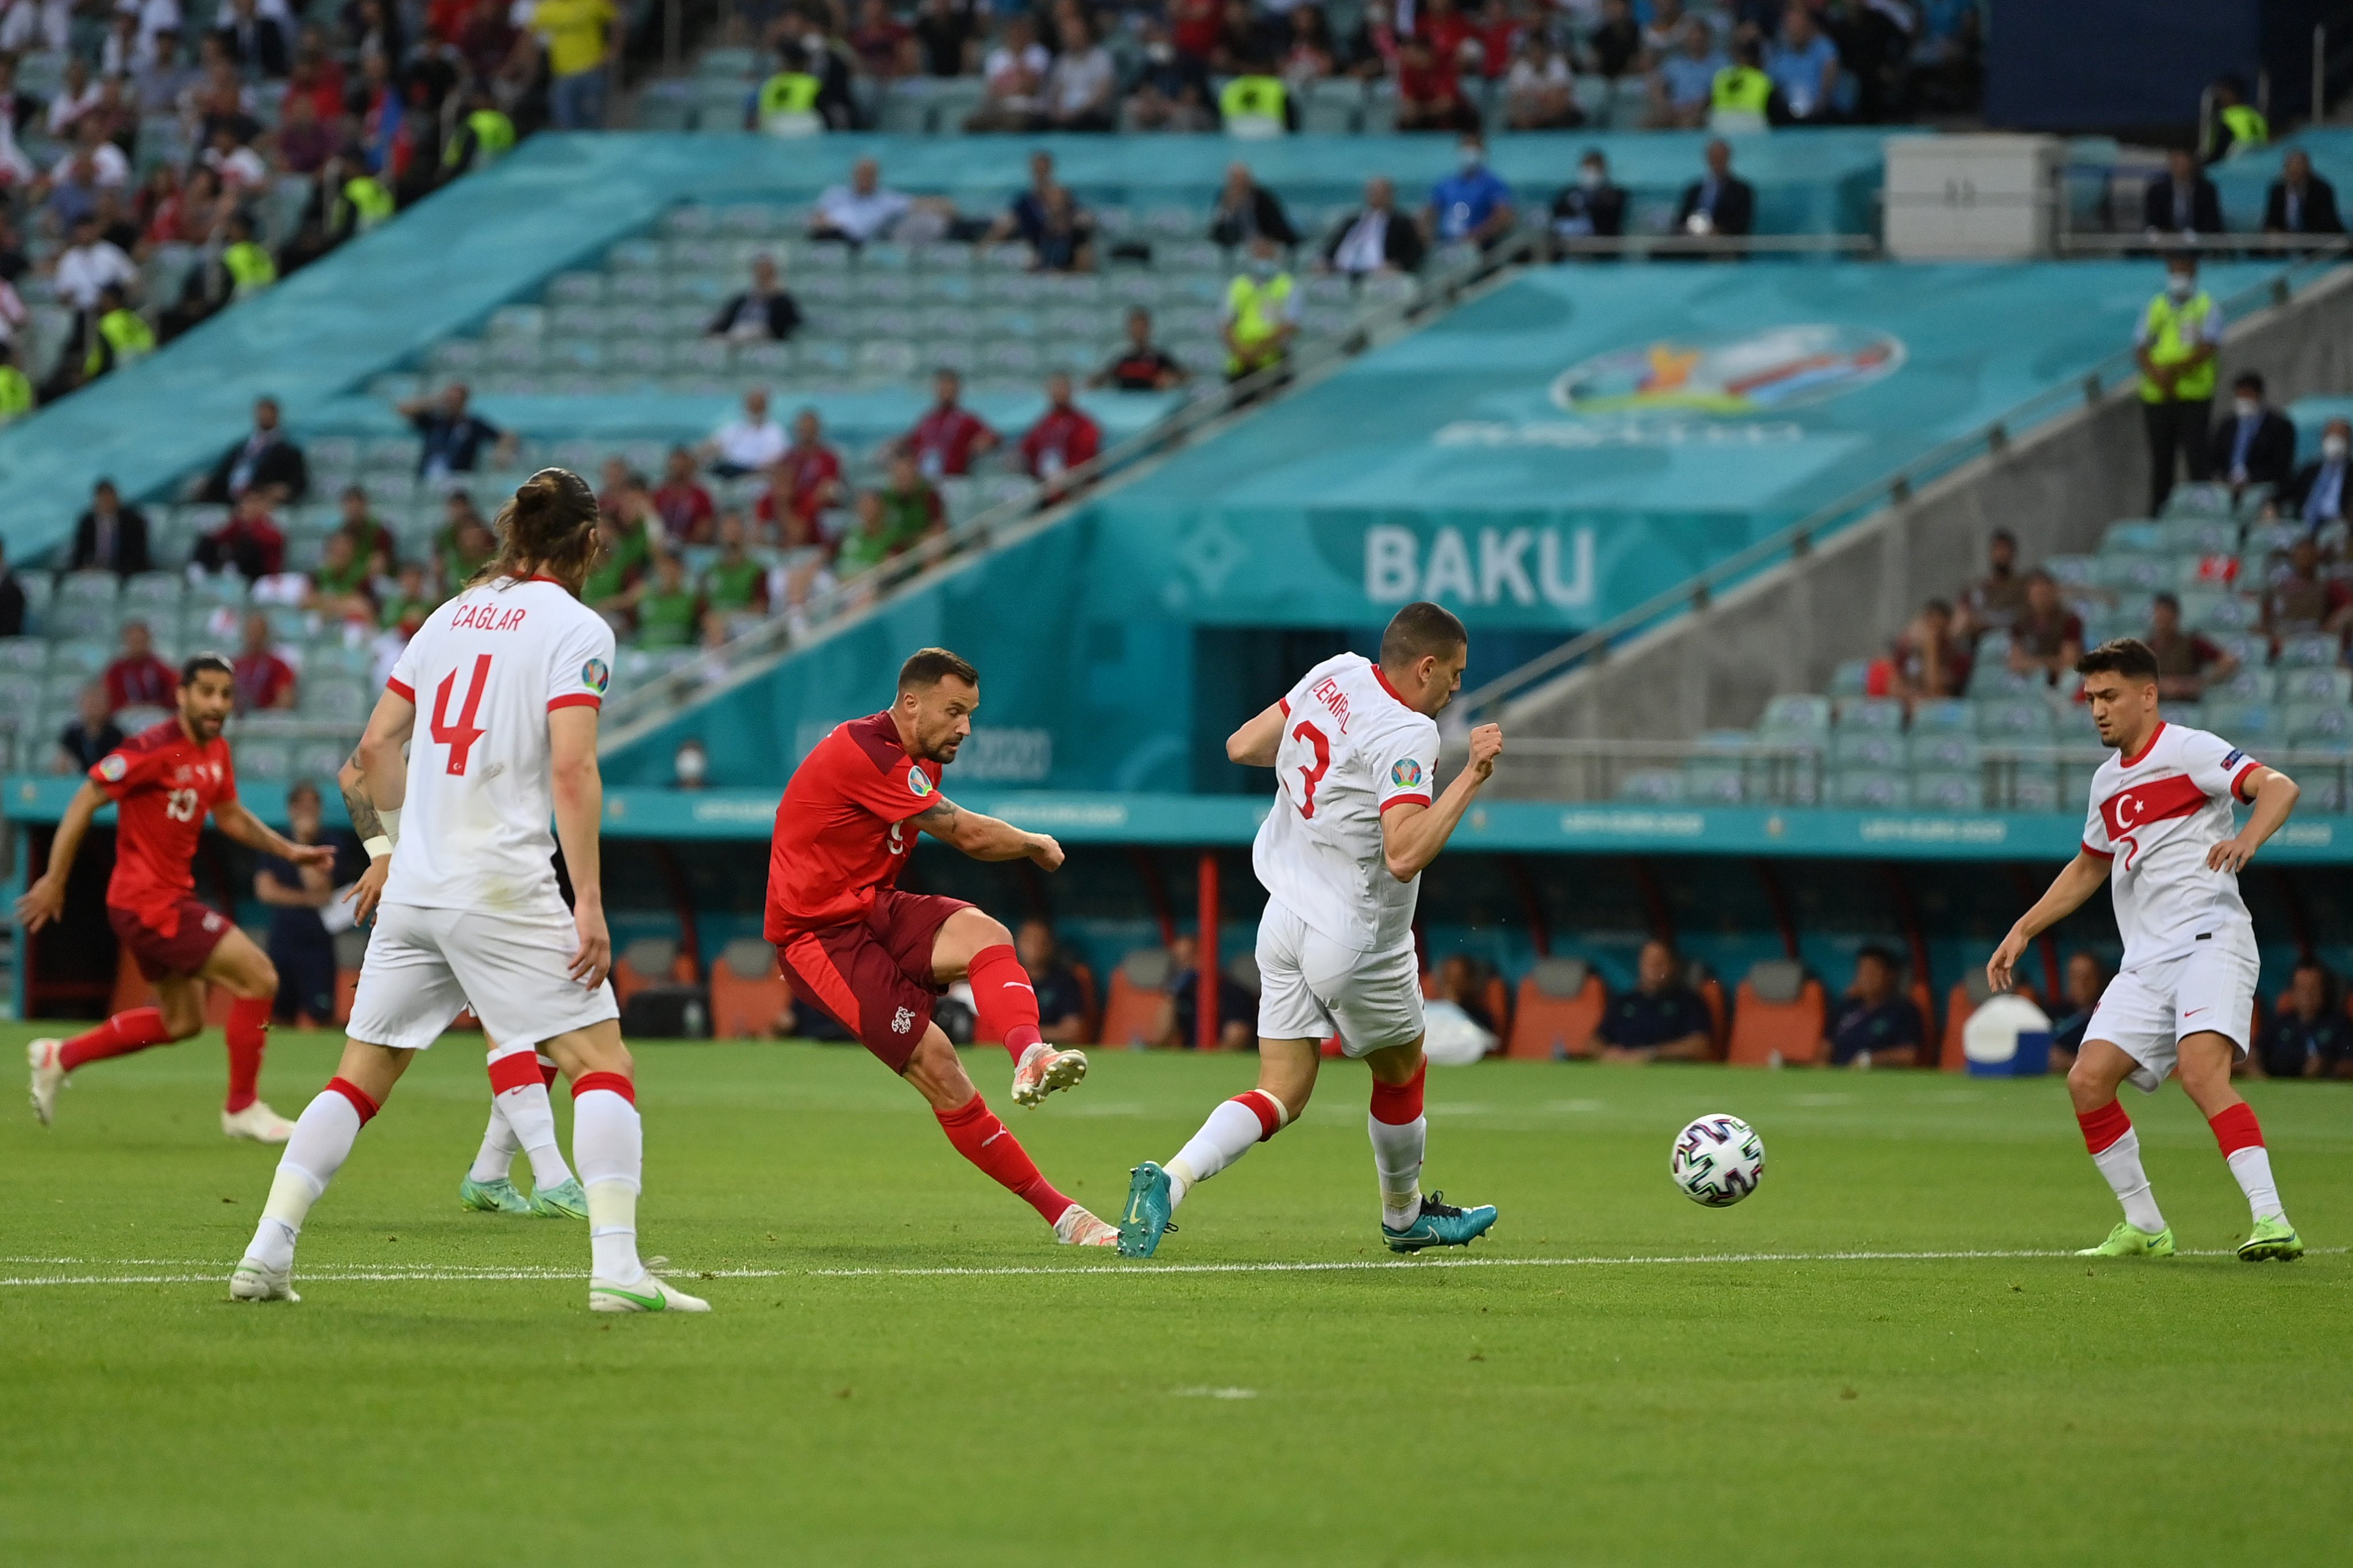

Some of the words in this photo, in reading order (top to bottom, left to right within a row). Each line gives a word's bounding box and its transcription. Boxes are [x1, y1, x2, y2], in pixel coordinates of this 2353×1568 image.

[1364, 525, 1595, 605] BAKU
[449, 603, 526, 631] ÇAĞLAR
[430, 654, 492, 776] 4
[1313, 678, 1350, 735] EMİRL
[1283, 720, 1330, 820] 3
[2120, 836, 2138, 871] 7
